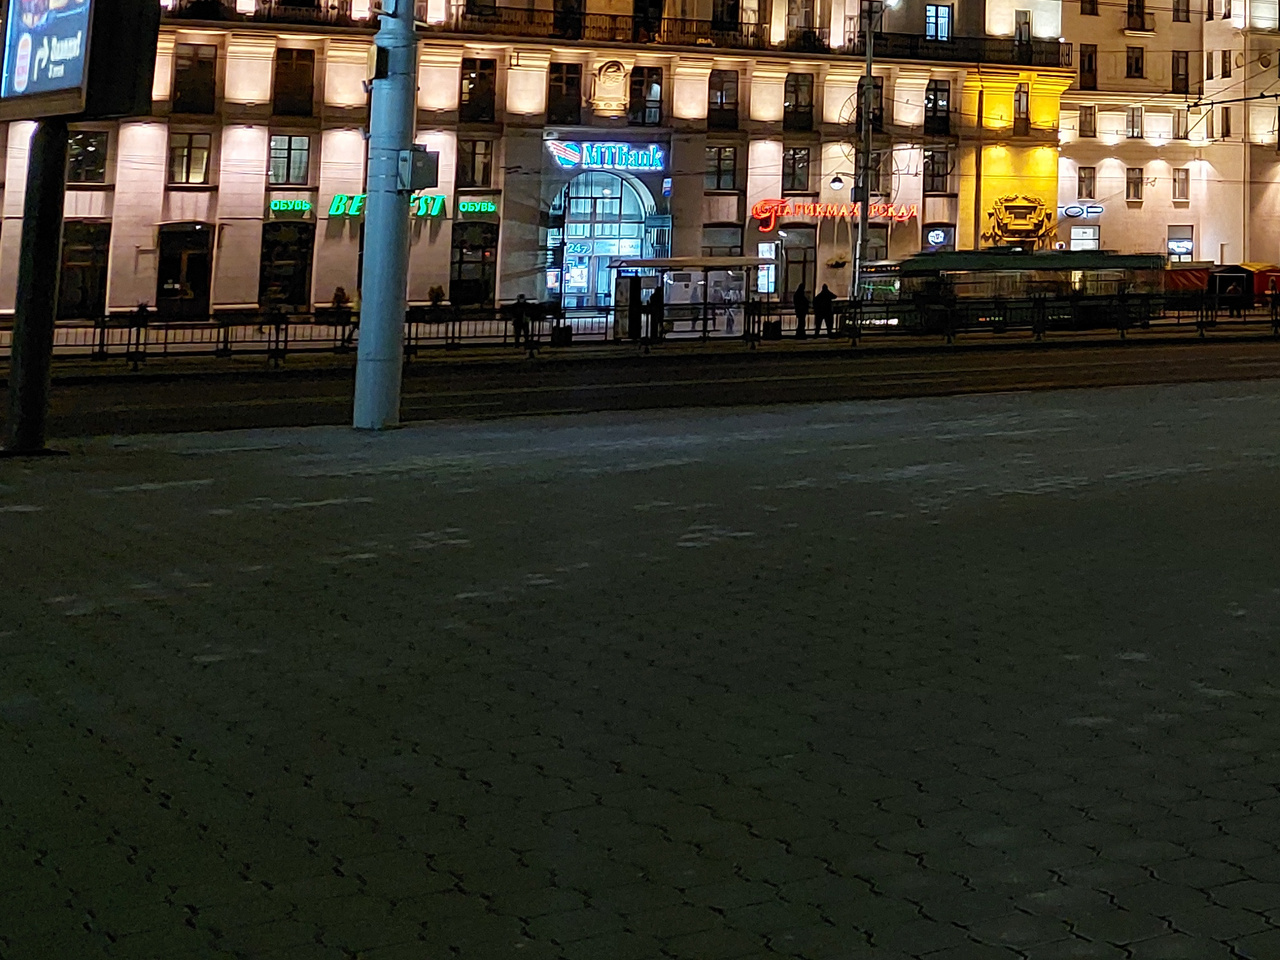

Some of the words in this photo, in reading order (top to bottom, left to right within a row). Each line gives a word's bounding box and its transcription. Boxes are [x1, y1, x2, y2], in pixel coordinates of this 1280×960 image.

[270, 200, 312, 212] ОБУВЬ
[329, 193, 446, 216] BEST
[459, 201, 497, 213] ОБУВЬ
[752, 198, 918, 232] ПАРИКМАХРСКАЯ
